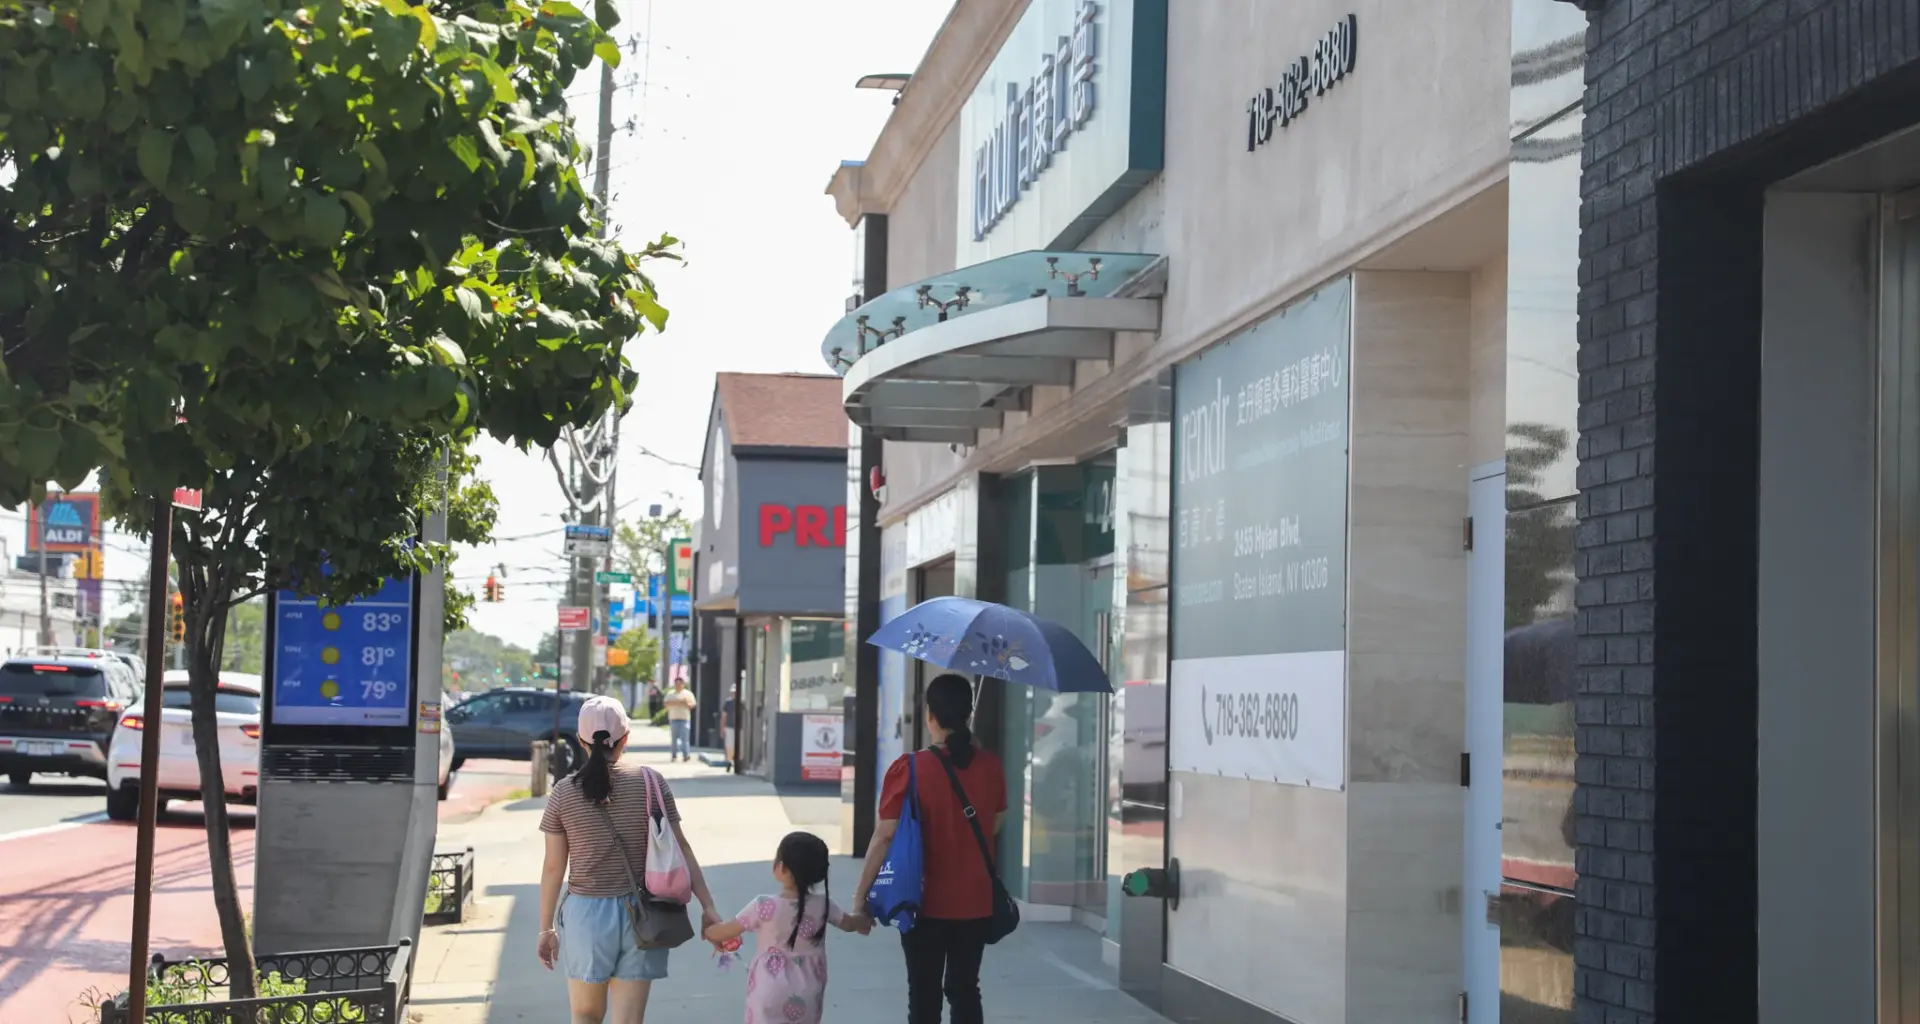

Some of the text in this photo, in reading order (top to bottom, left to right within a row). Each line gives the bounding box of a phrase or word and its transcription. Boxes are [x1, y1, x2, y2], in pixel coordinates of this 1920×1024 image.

[1246, 13, 1357, 152] 718-362-6880
[1181, 377, 1230, 484] rendr
[46, 529, 82, 543] ALDI
[1234, 515, 1301, 559] 2455 Hylan Blvd,
[1234, 557, 1327, 601] Staten Island, NY 10306
[362, 612, 401, 632] 83°
[361, 646, 395, 667] 81°
[360, 680, 397, 699] 79°
[1215, 692, 1299, 741] 718-362-6880
